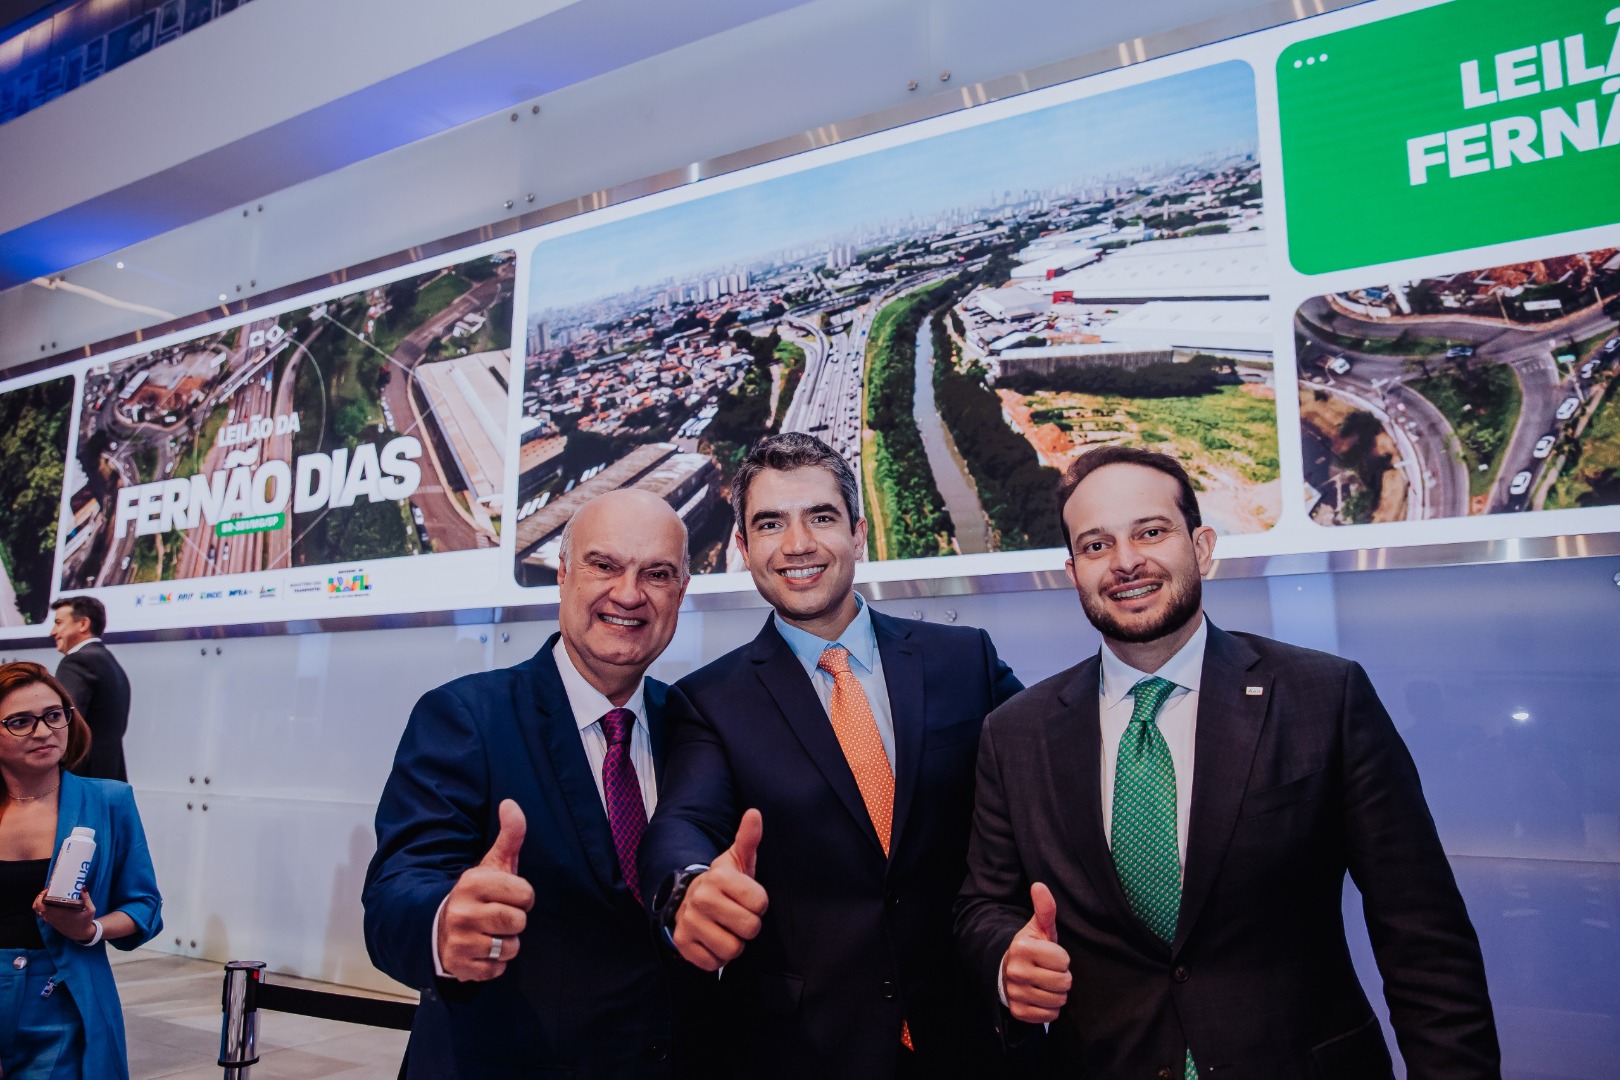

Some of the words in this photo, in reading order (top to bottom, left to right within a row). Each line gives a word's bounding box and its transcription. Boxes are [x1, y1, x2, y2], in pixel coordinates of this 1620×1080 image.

[218, 413, 273, 448] LEILÃO
[276, 412, 300, 435] DA
[114, 444, 293, 539] FERNÃO
[293, 435, 423, 514] DIAS
